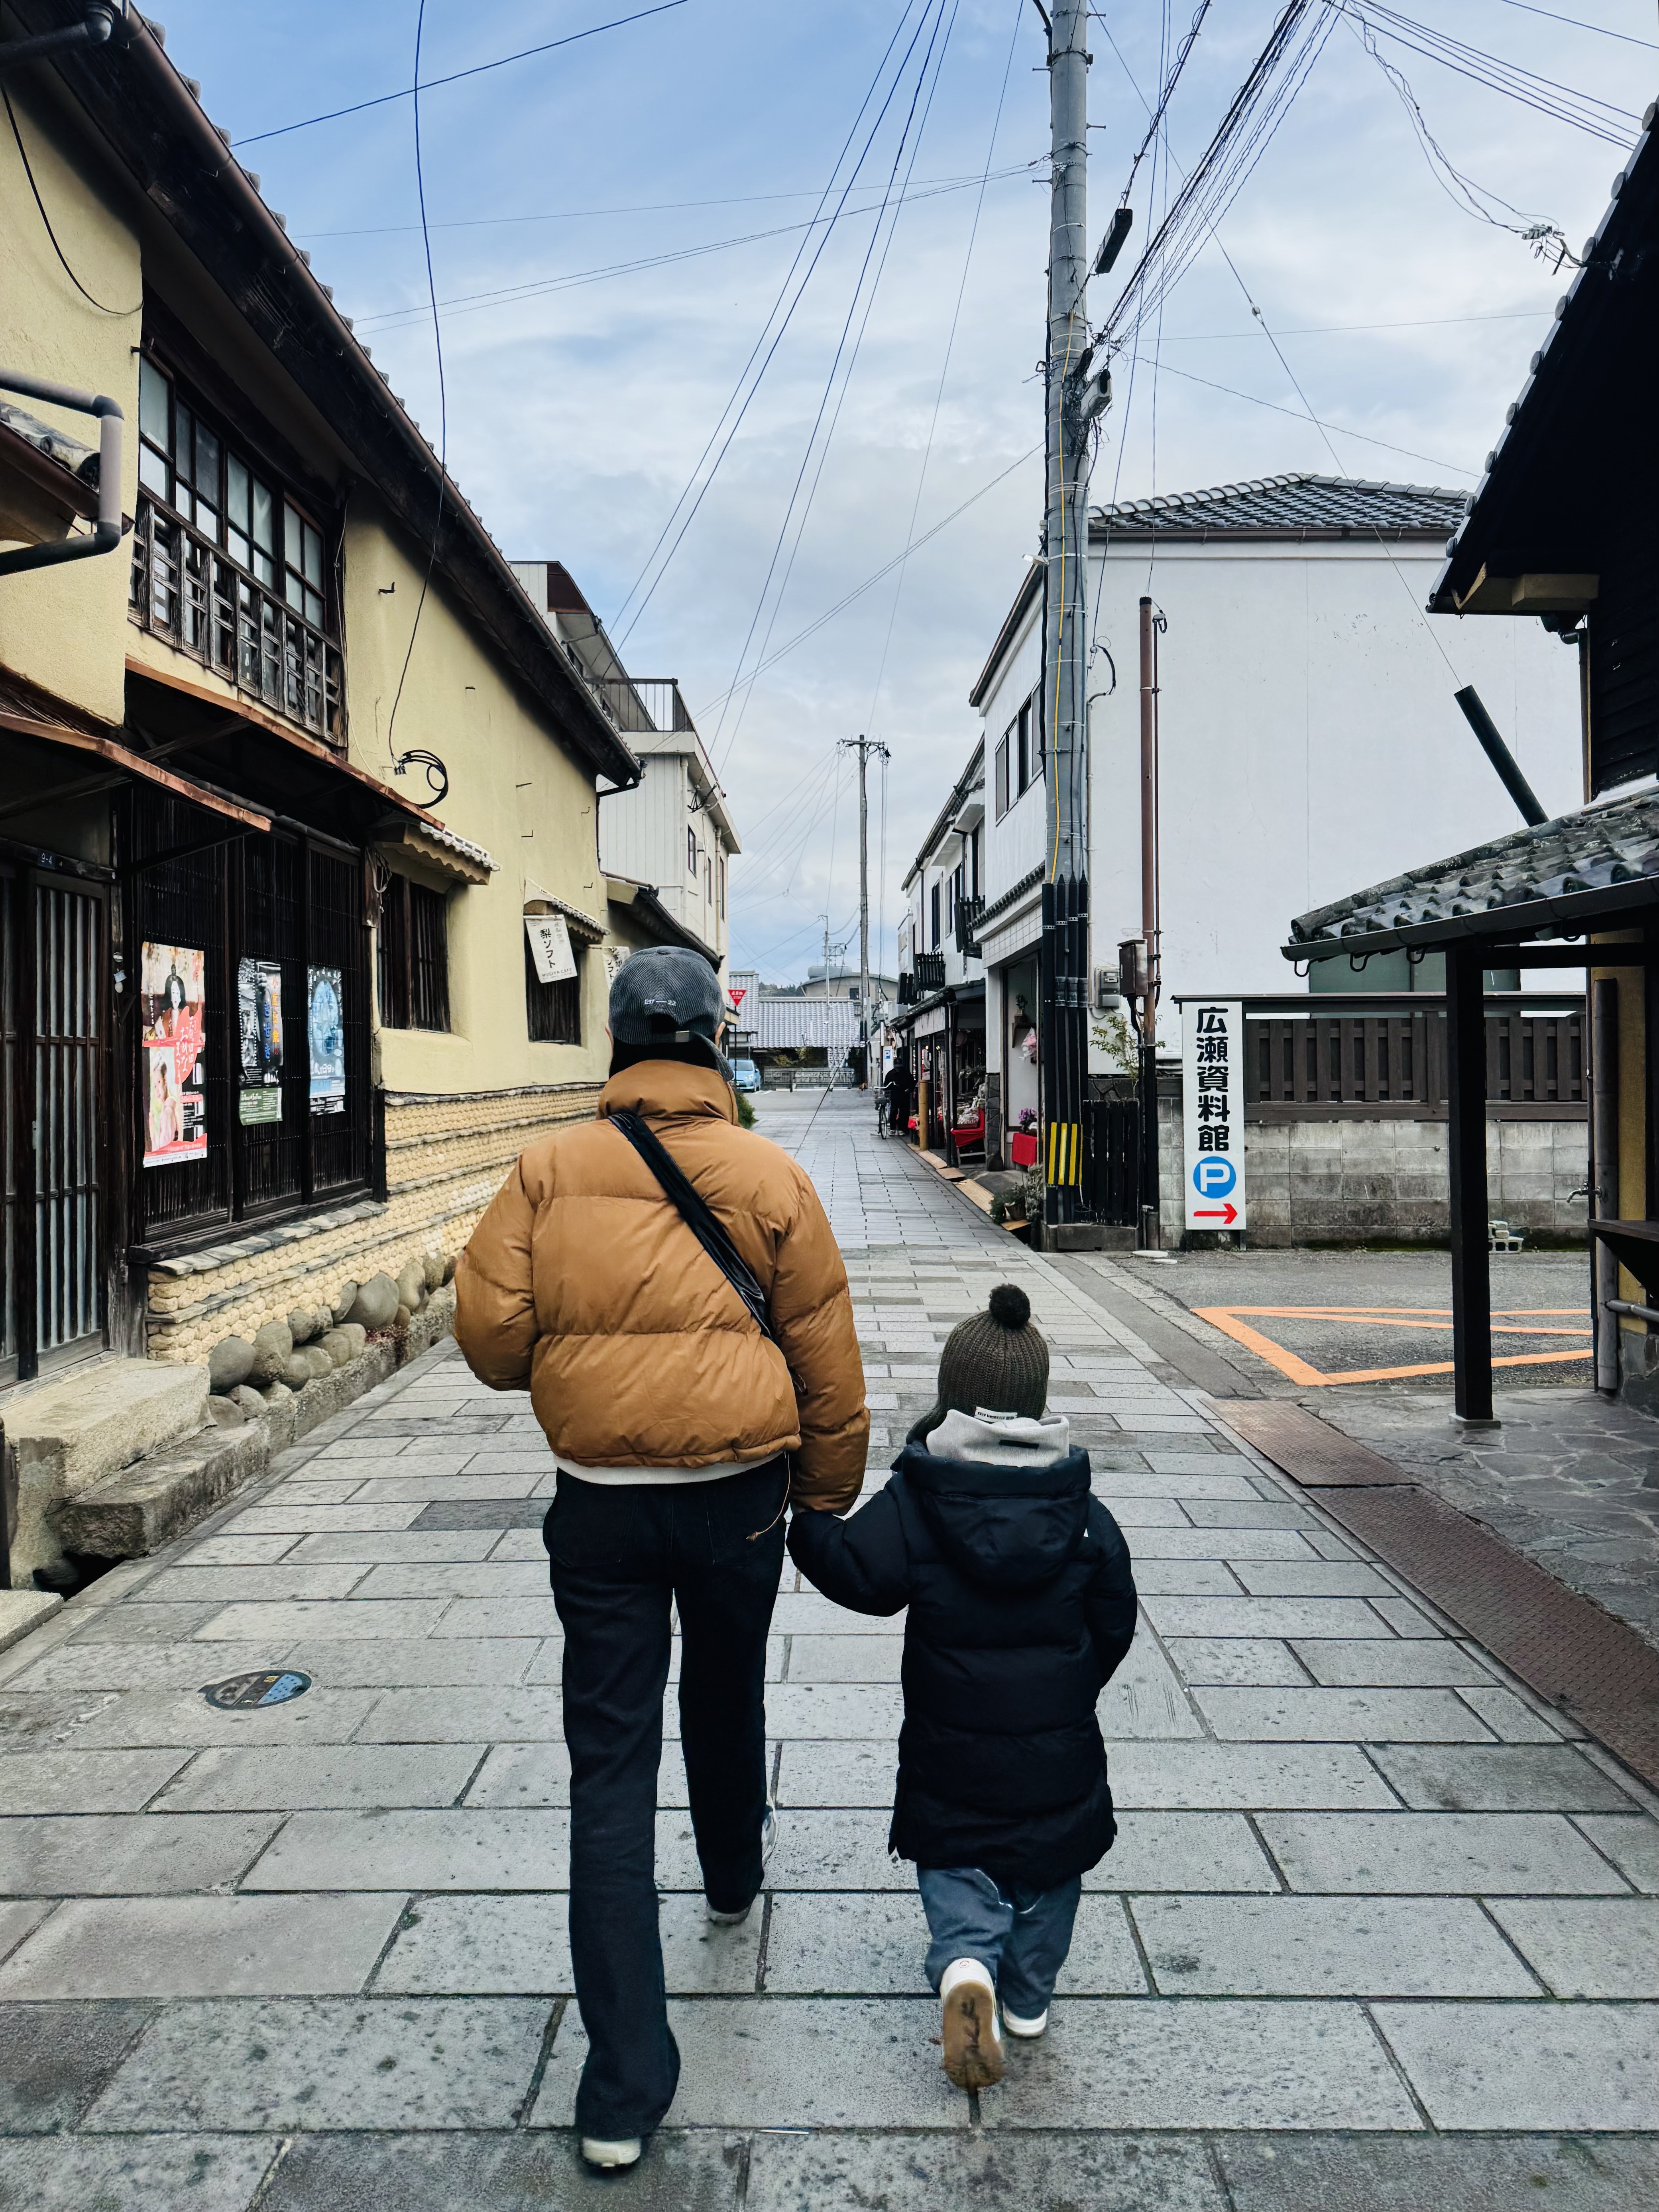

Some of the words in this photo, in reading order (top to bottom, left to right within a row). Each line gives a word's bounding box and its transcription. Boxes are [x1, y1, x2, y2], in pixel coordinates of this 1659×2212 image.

[41, 853, 52, 864] 9-4
[540, 928, 556, 968] 梨ソフト
[885, 1050, 890, 1059] P
[1196, 1006, 1230, 1152] 広瀬資料館
[1200, 1163, 1230, 1192] P
